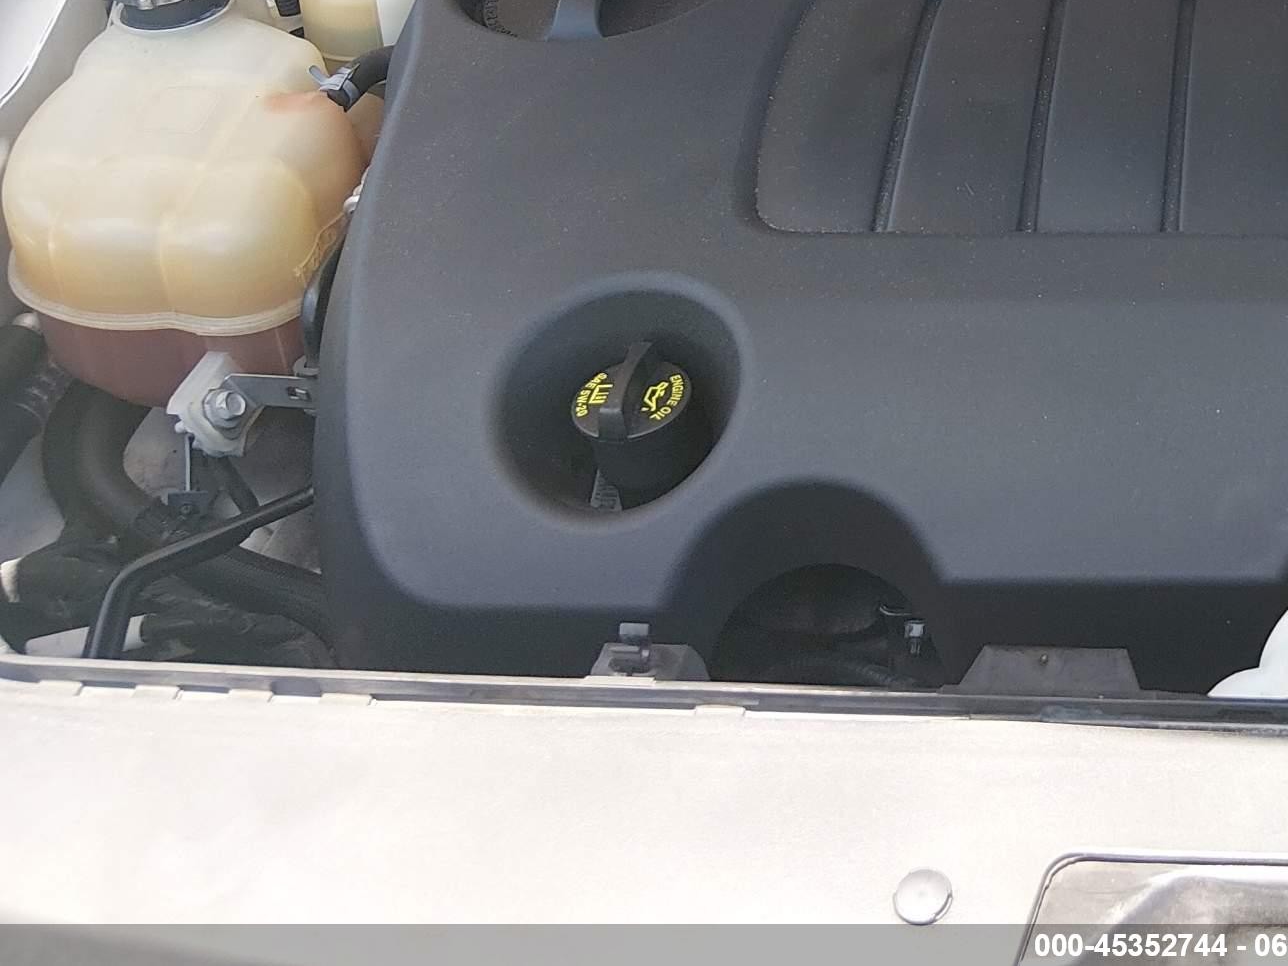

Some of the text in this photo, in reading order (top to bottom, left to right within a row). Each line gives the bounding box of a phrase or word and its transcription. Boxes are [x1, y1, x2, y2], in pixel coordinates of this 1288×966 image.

[585, 372, 608, 389] SAE
[649, 374, 685, 420] ENGINE OIL
